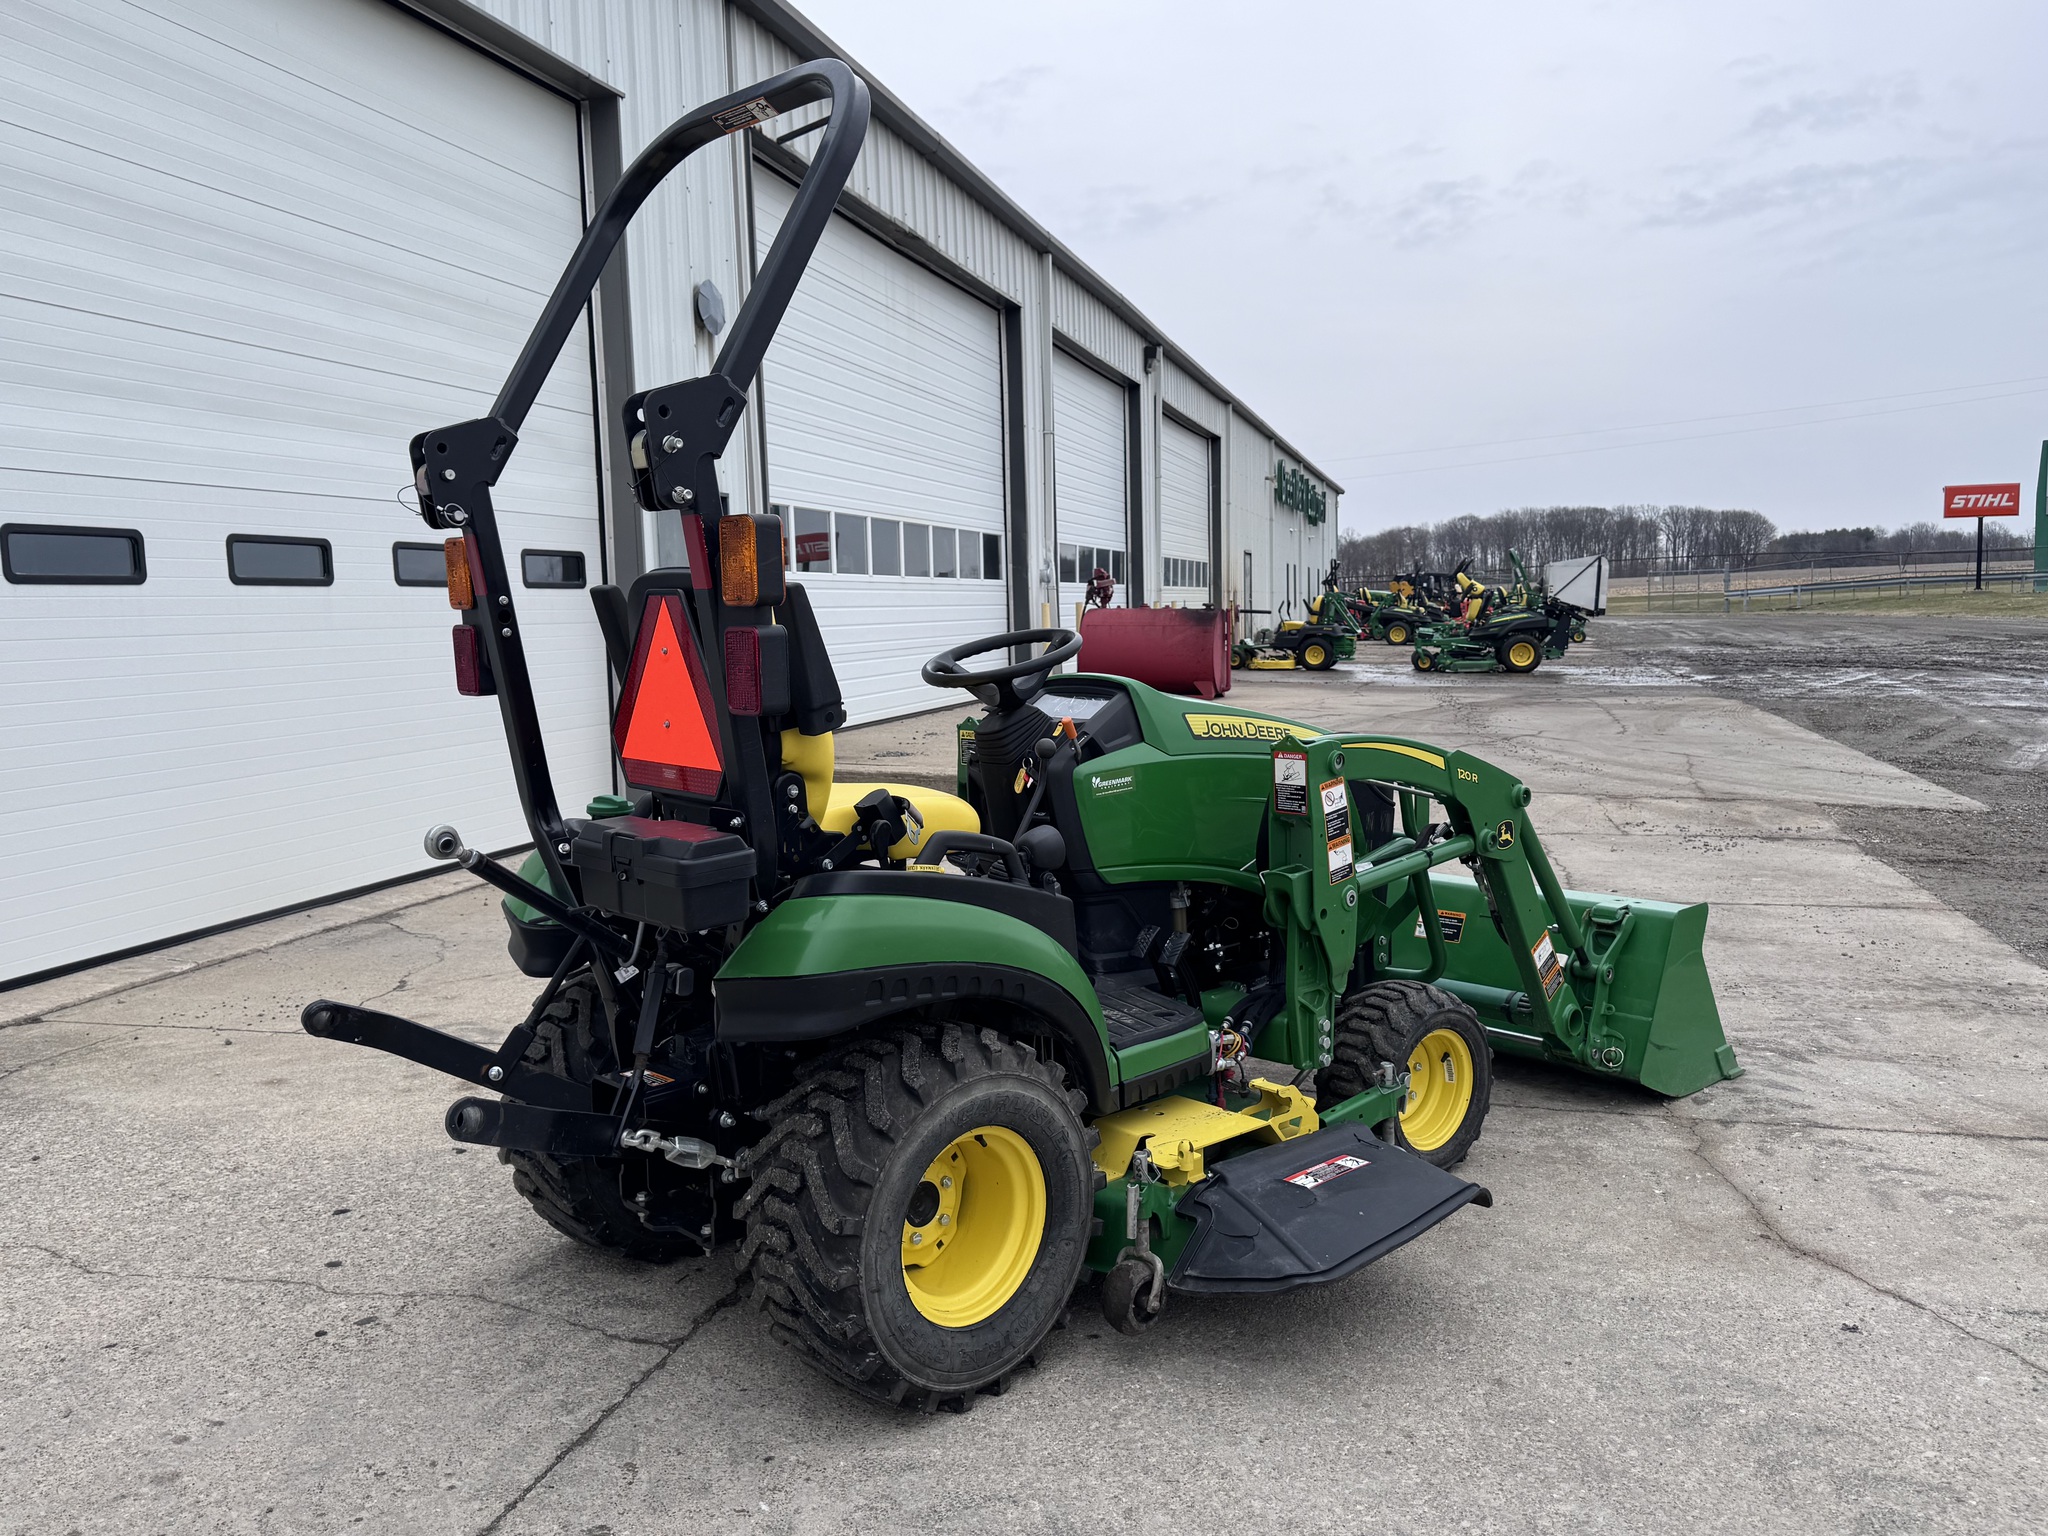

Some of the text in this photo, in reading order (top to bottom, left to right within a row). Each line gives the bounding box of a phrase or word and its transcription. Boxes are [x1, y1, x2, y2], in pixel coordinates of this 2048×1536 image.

[1950, 493, 2014, 508] STIHL
[1202, 720, 1243, 737] JOHN
[957, 1095, 1069, 1151] CARLISLE
